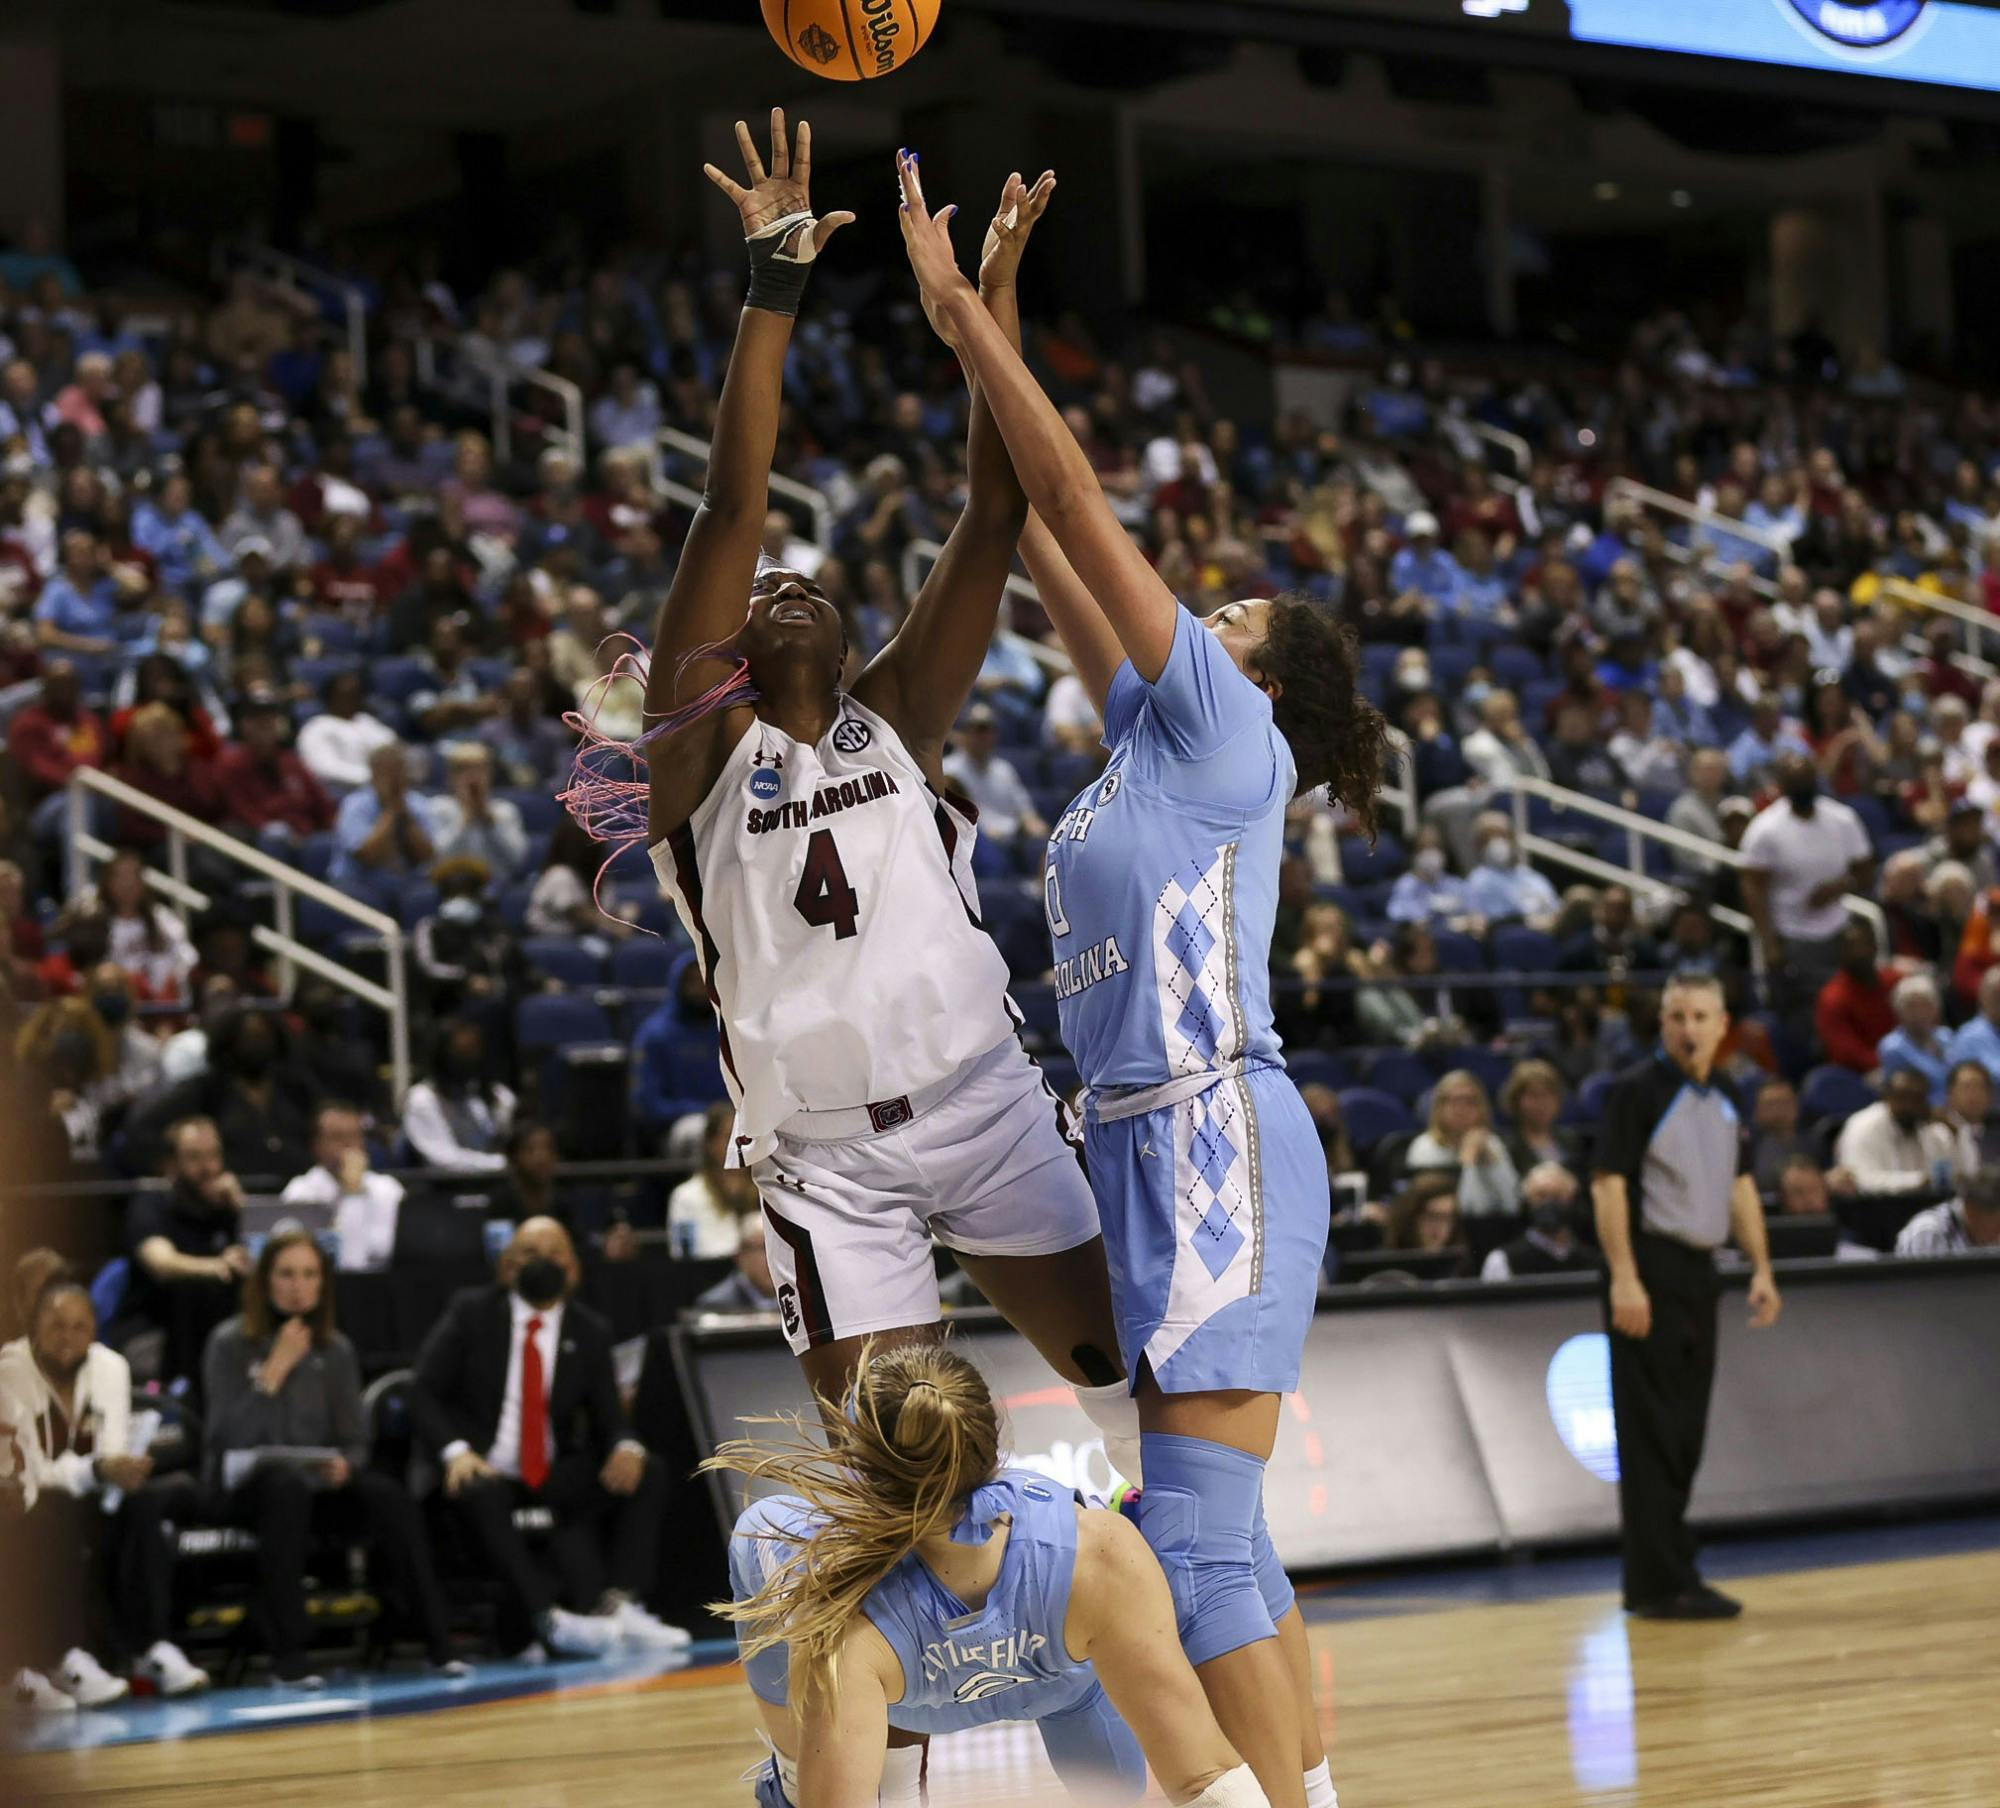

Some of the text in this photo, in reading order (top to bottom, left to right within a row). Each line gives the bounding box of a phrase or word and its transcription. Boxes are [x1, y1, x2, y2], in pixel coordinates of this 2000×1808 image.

[836, 721, 870, 751] SEC
[746, 770, 900, 835] SOUTH AROLINA
[753, 780, 779, 792] NCAA
[793, 828, 860, 941] 4
[1054, 935, 1129, 1001] ROLINA
